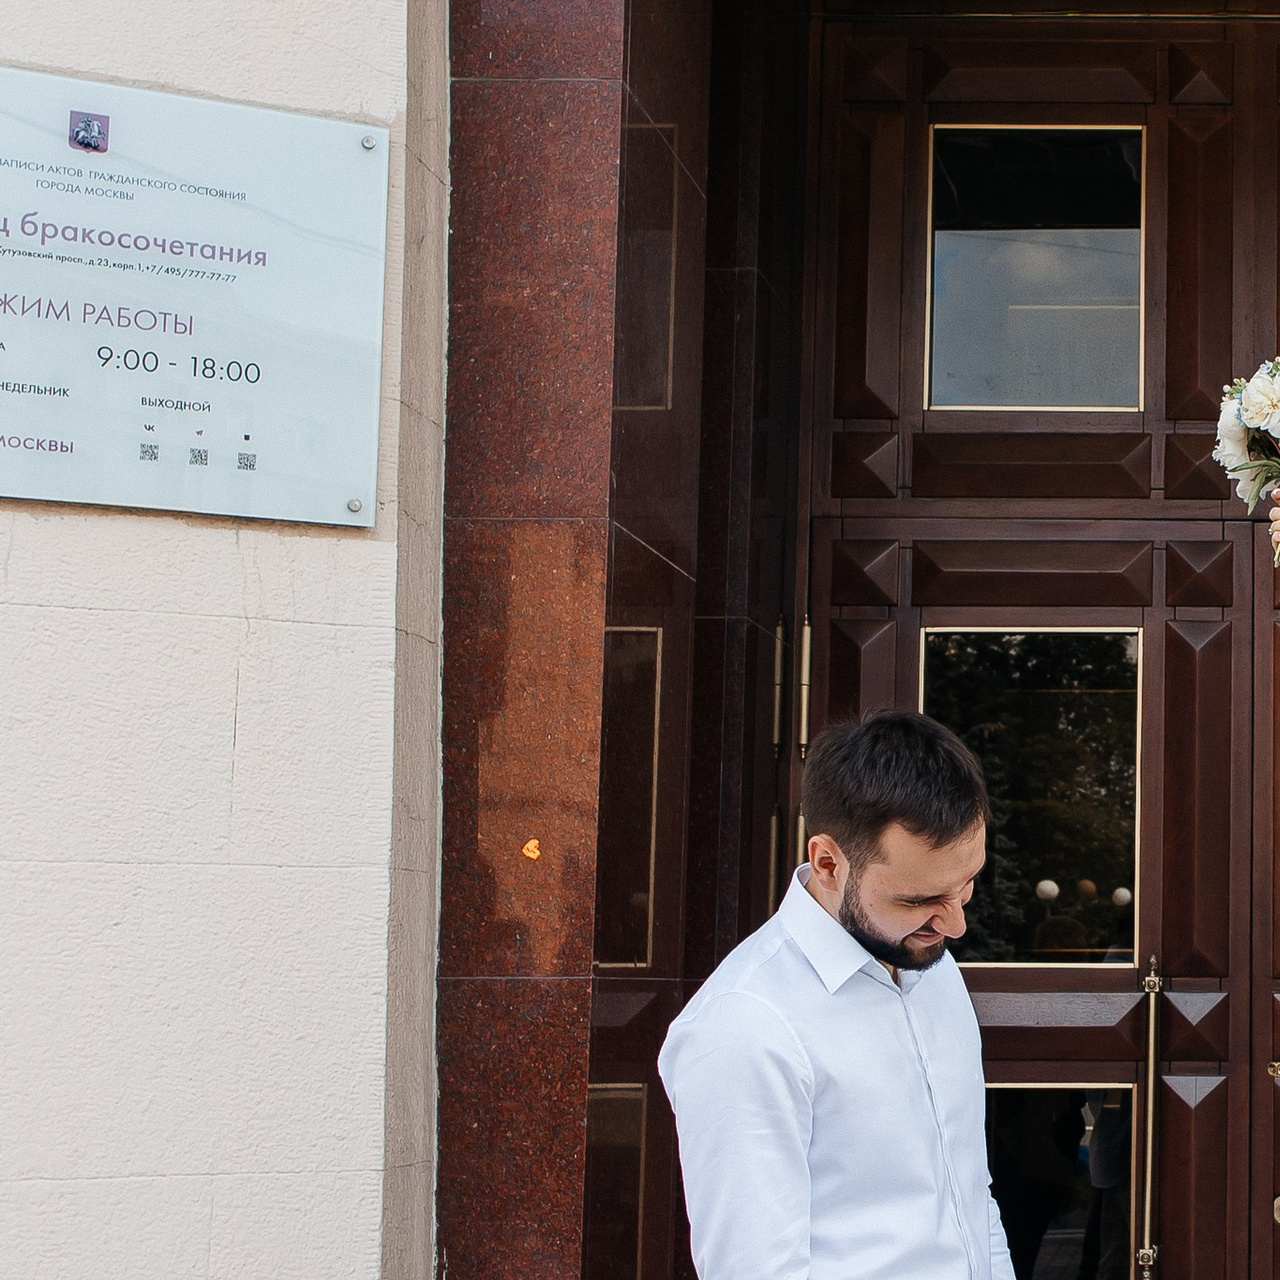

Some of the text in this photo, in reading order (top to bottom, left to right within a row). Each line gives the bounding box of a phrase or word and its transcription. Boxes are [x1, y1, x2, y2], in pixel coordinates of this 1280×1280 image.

[35, 179, 134, 201] ГОРОДА МОСКВЫ
[47, 165, 83, 178] АКТОВ
[89, 170, 177, 191] ГРАЖДАНСКОГО
[179, 183, 247, 201] СОСТОЯНИЯ
[20, 211, 267, 267] бракосочетания
[82, 302, 193, 335] РАБОТЫ
[97, 346, 159, 373] 9:00
[190, 356, 261, 384] 18:00
[141, 396, 211, 412] ВЫХОДНОЙ
